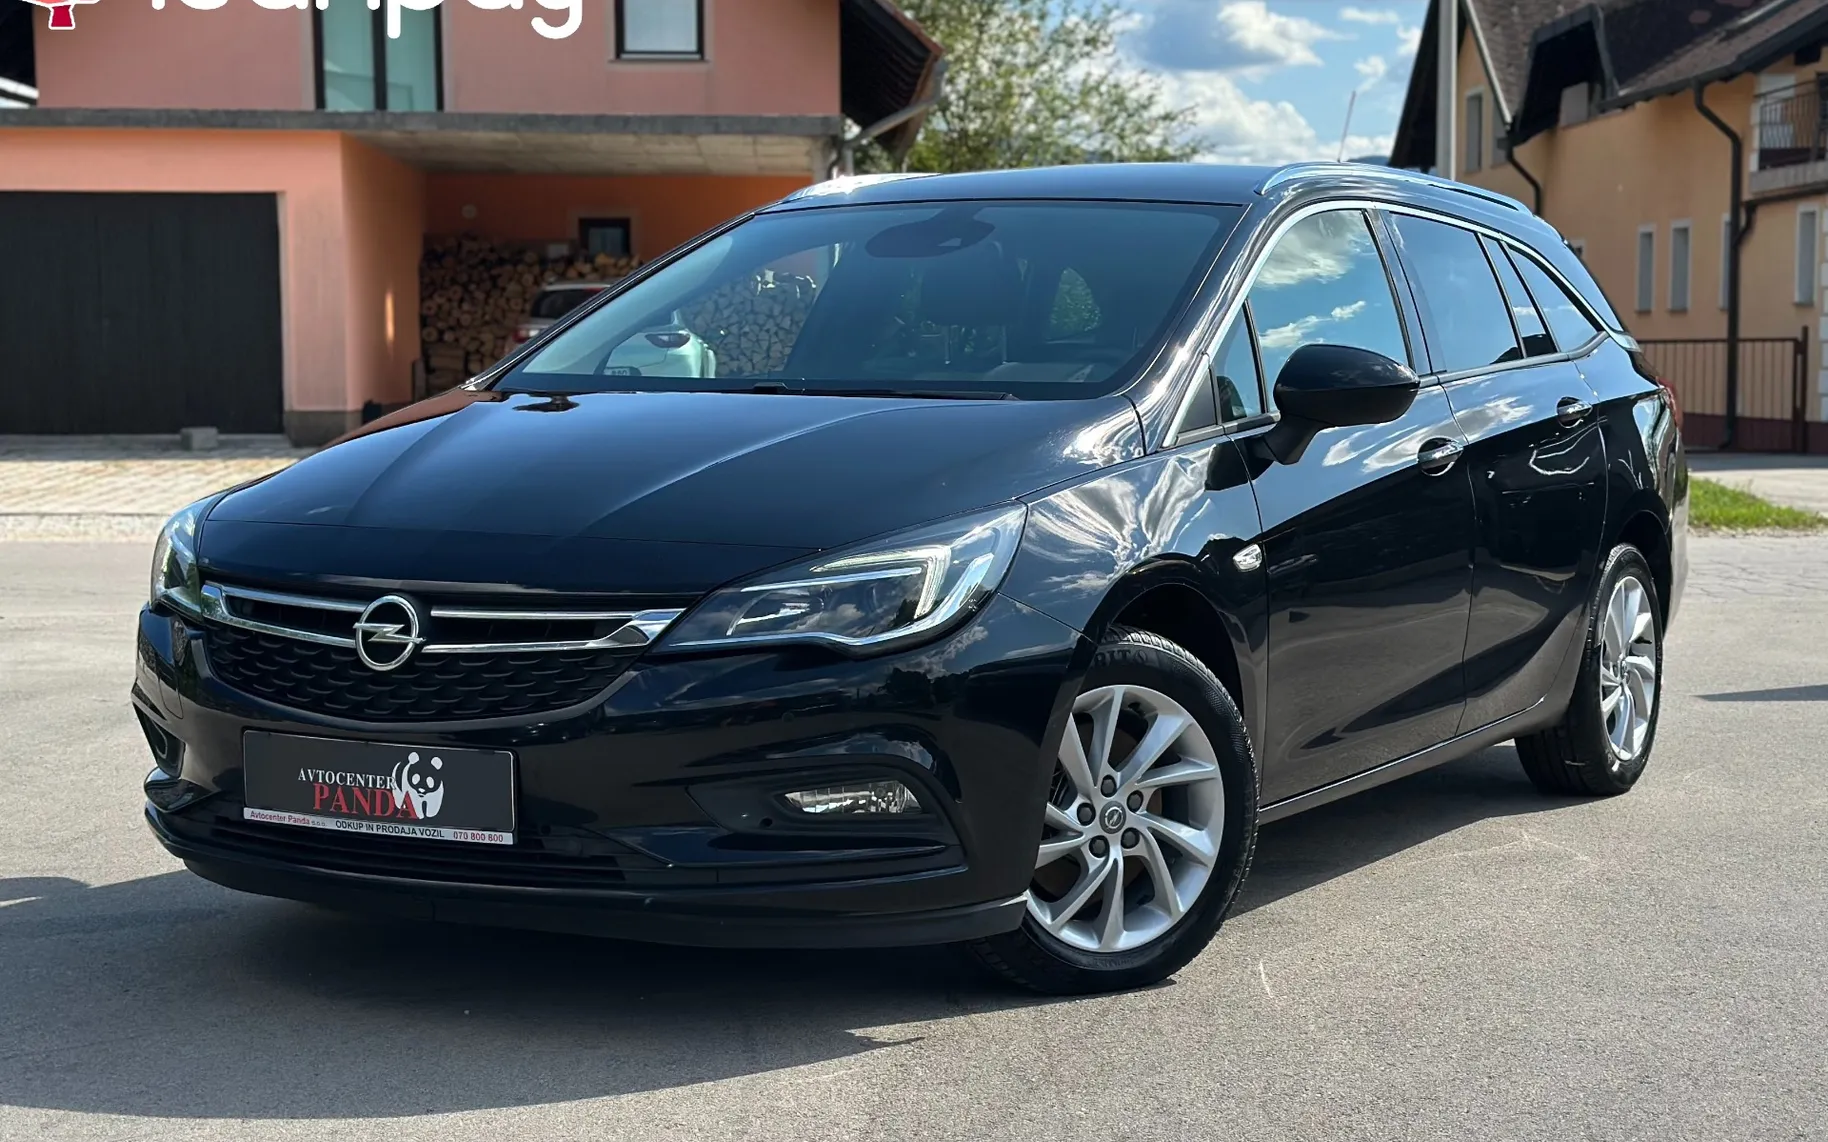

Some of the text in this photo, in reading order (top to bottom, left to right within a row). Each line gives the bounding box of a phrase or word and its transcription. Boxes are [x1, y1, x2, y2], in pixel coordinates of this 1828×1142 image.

[298, 768, 397, 791] AVTOCENTER
[313, 782, 420, 819] PANDA
[250, 810, 286, 822] Avtocenter
[288, 814, 310, 825] Panda
[335, 820, 364, 831] ODKUP
[365, 823, 374, 832] IN
[376, 824, 418, 836] PRODAJA
[419, 828, 445, 838] VOZIL
[453, 831, 469, 840] 070
[470, 832, 486, 842] 800
